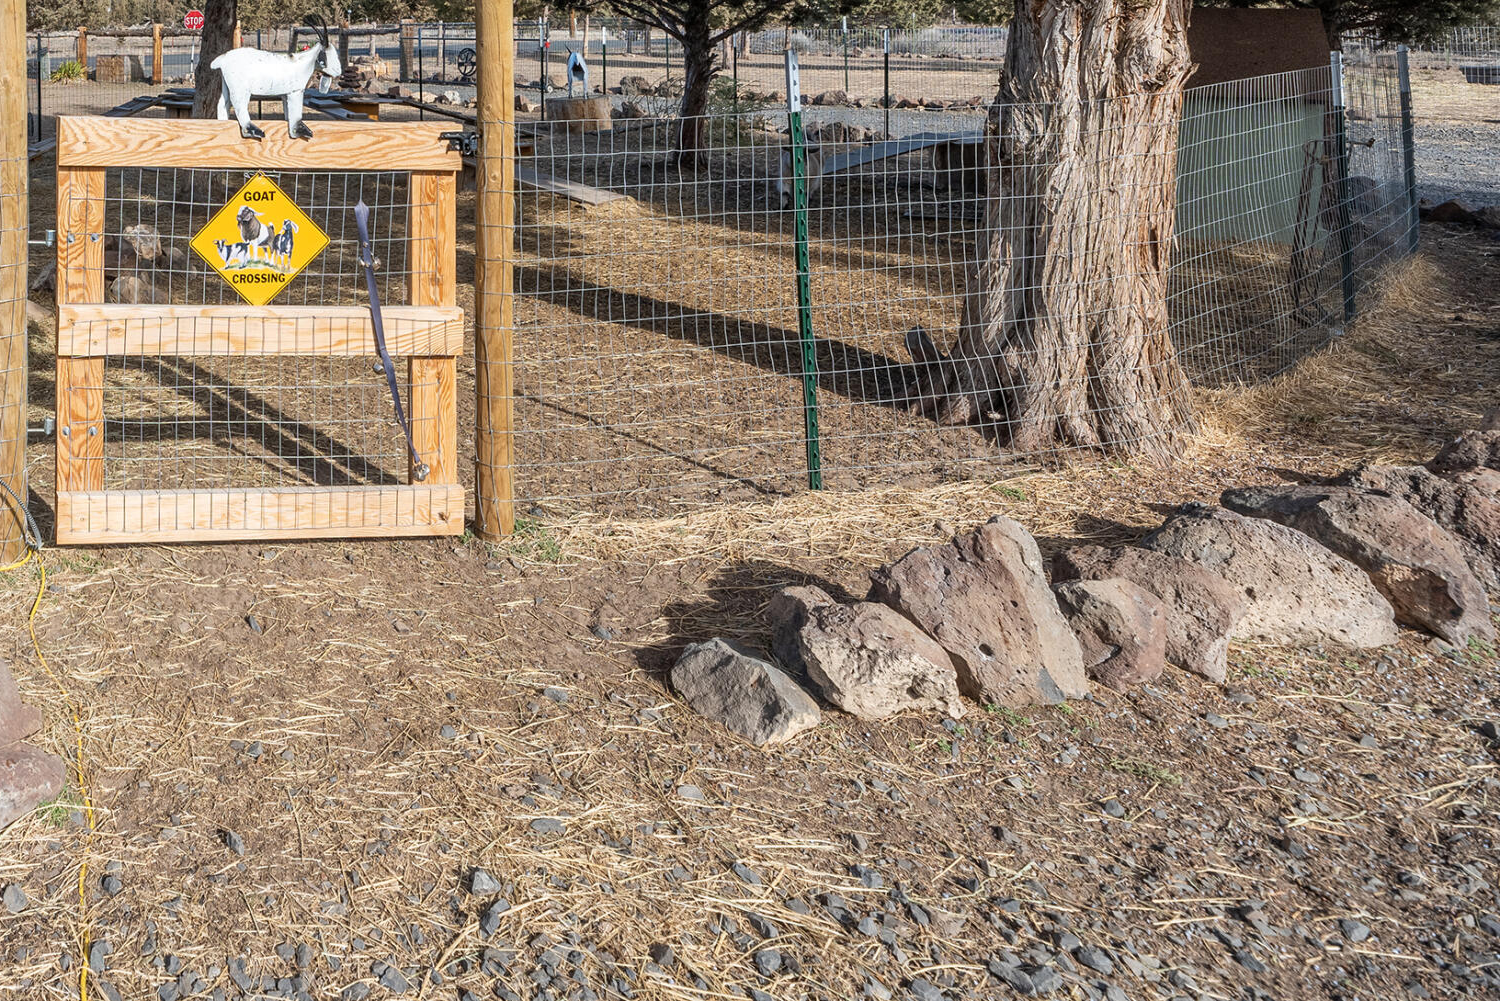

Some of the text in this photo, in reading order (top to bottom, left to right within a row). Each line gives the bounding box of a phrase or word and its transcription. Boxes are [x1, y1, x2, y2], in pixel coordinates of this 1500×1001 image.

[186, 16, 204, 25] STOP
[243, 191, 276, 201] GOAT
[232, 273, 285, 284] CROSSING
